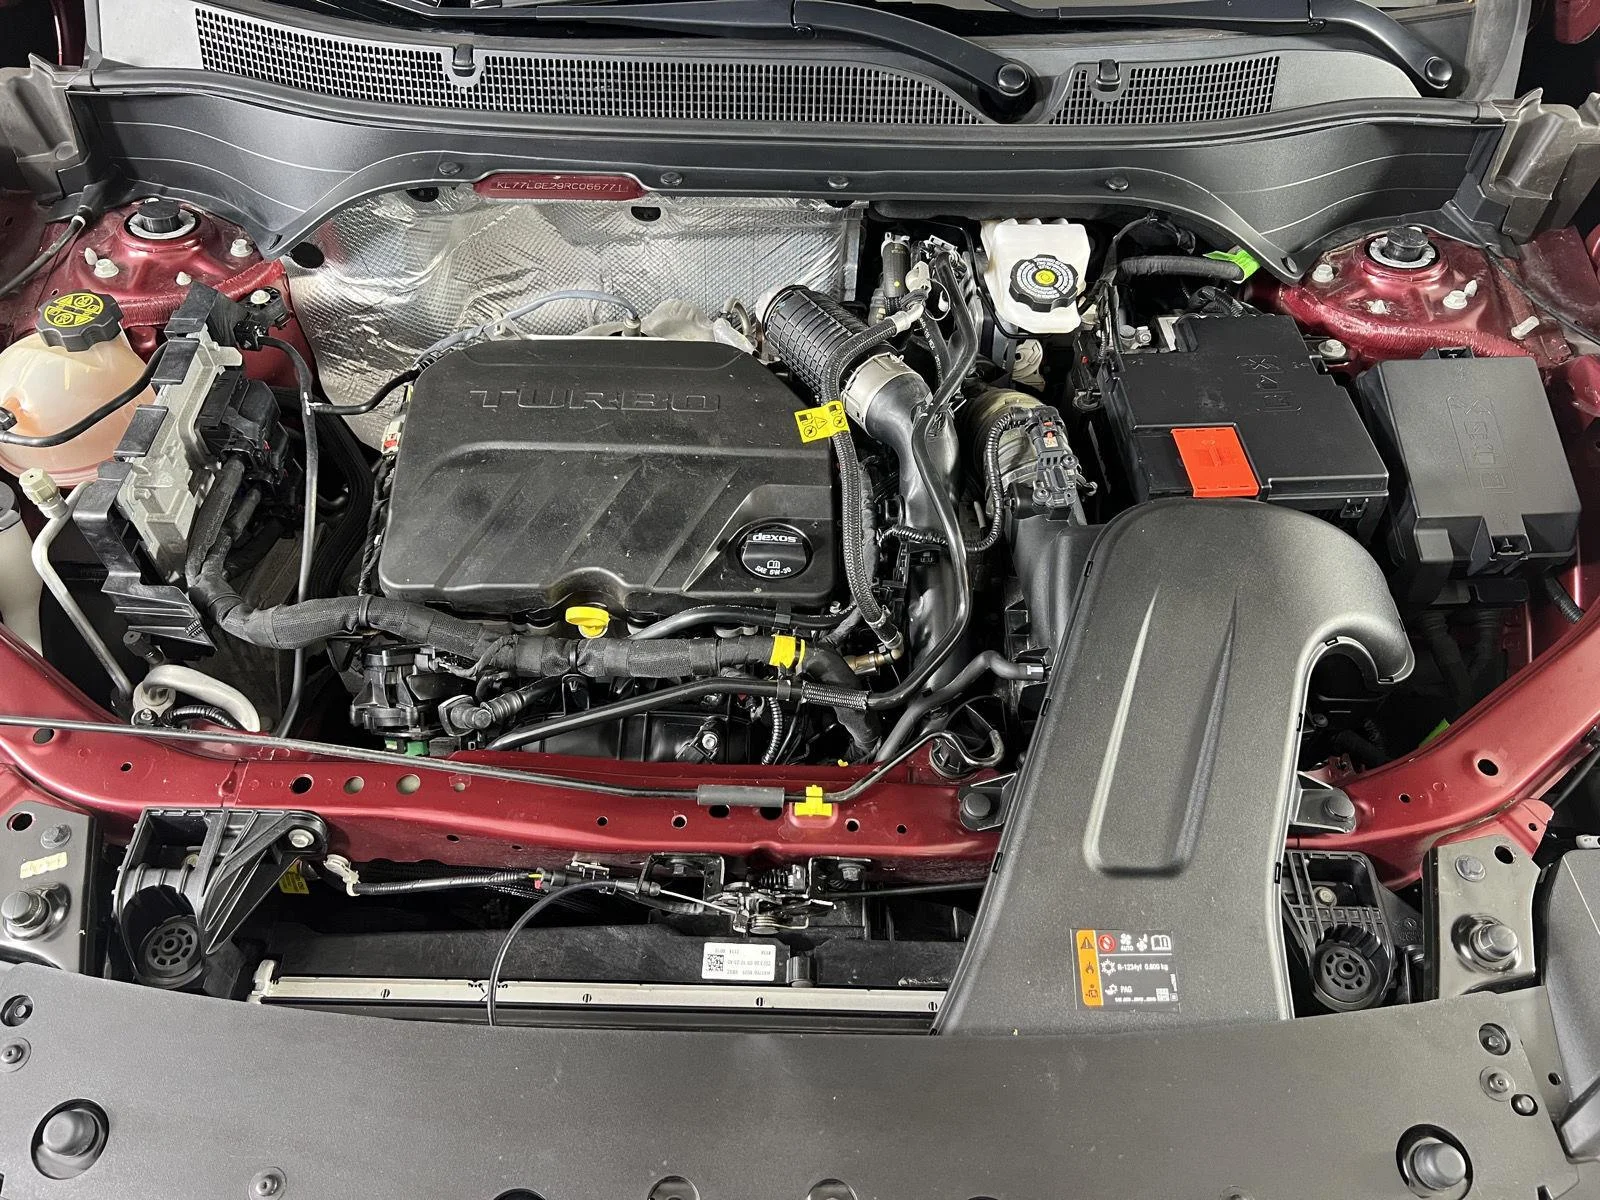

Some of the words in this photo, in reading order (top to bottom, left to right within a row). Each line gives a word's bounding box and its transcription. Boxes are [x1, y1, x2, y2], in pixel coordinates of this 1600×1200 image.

[470, 389, 720, 412] TURBO
[752, 533, 798, 543] dexos
[1120, 985, 1133, 993] PAG
